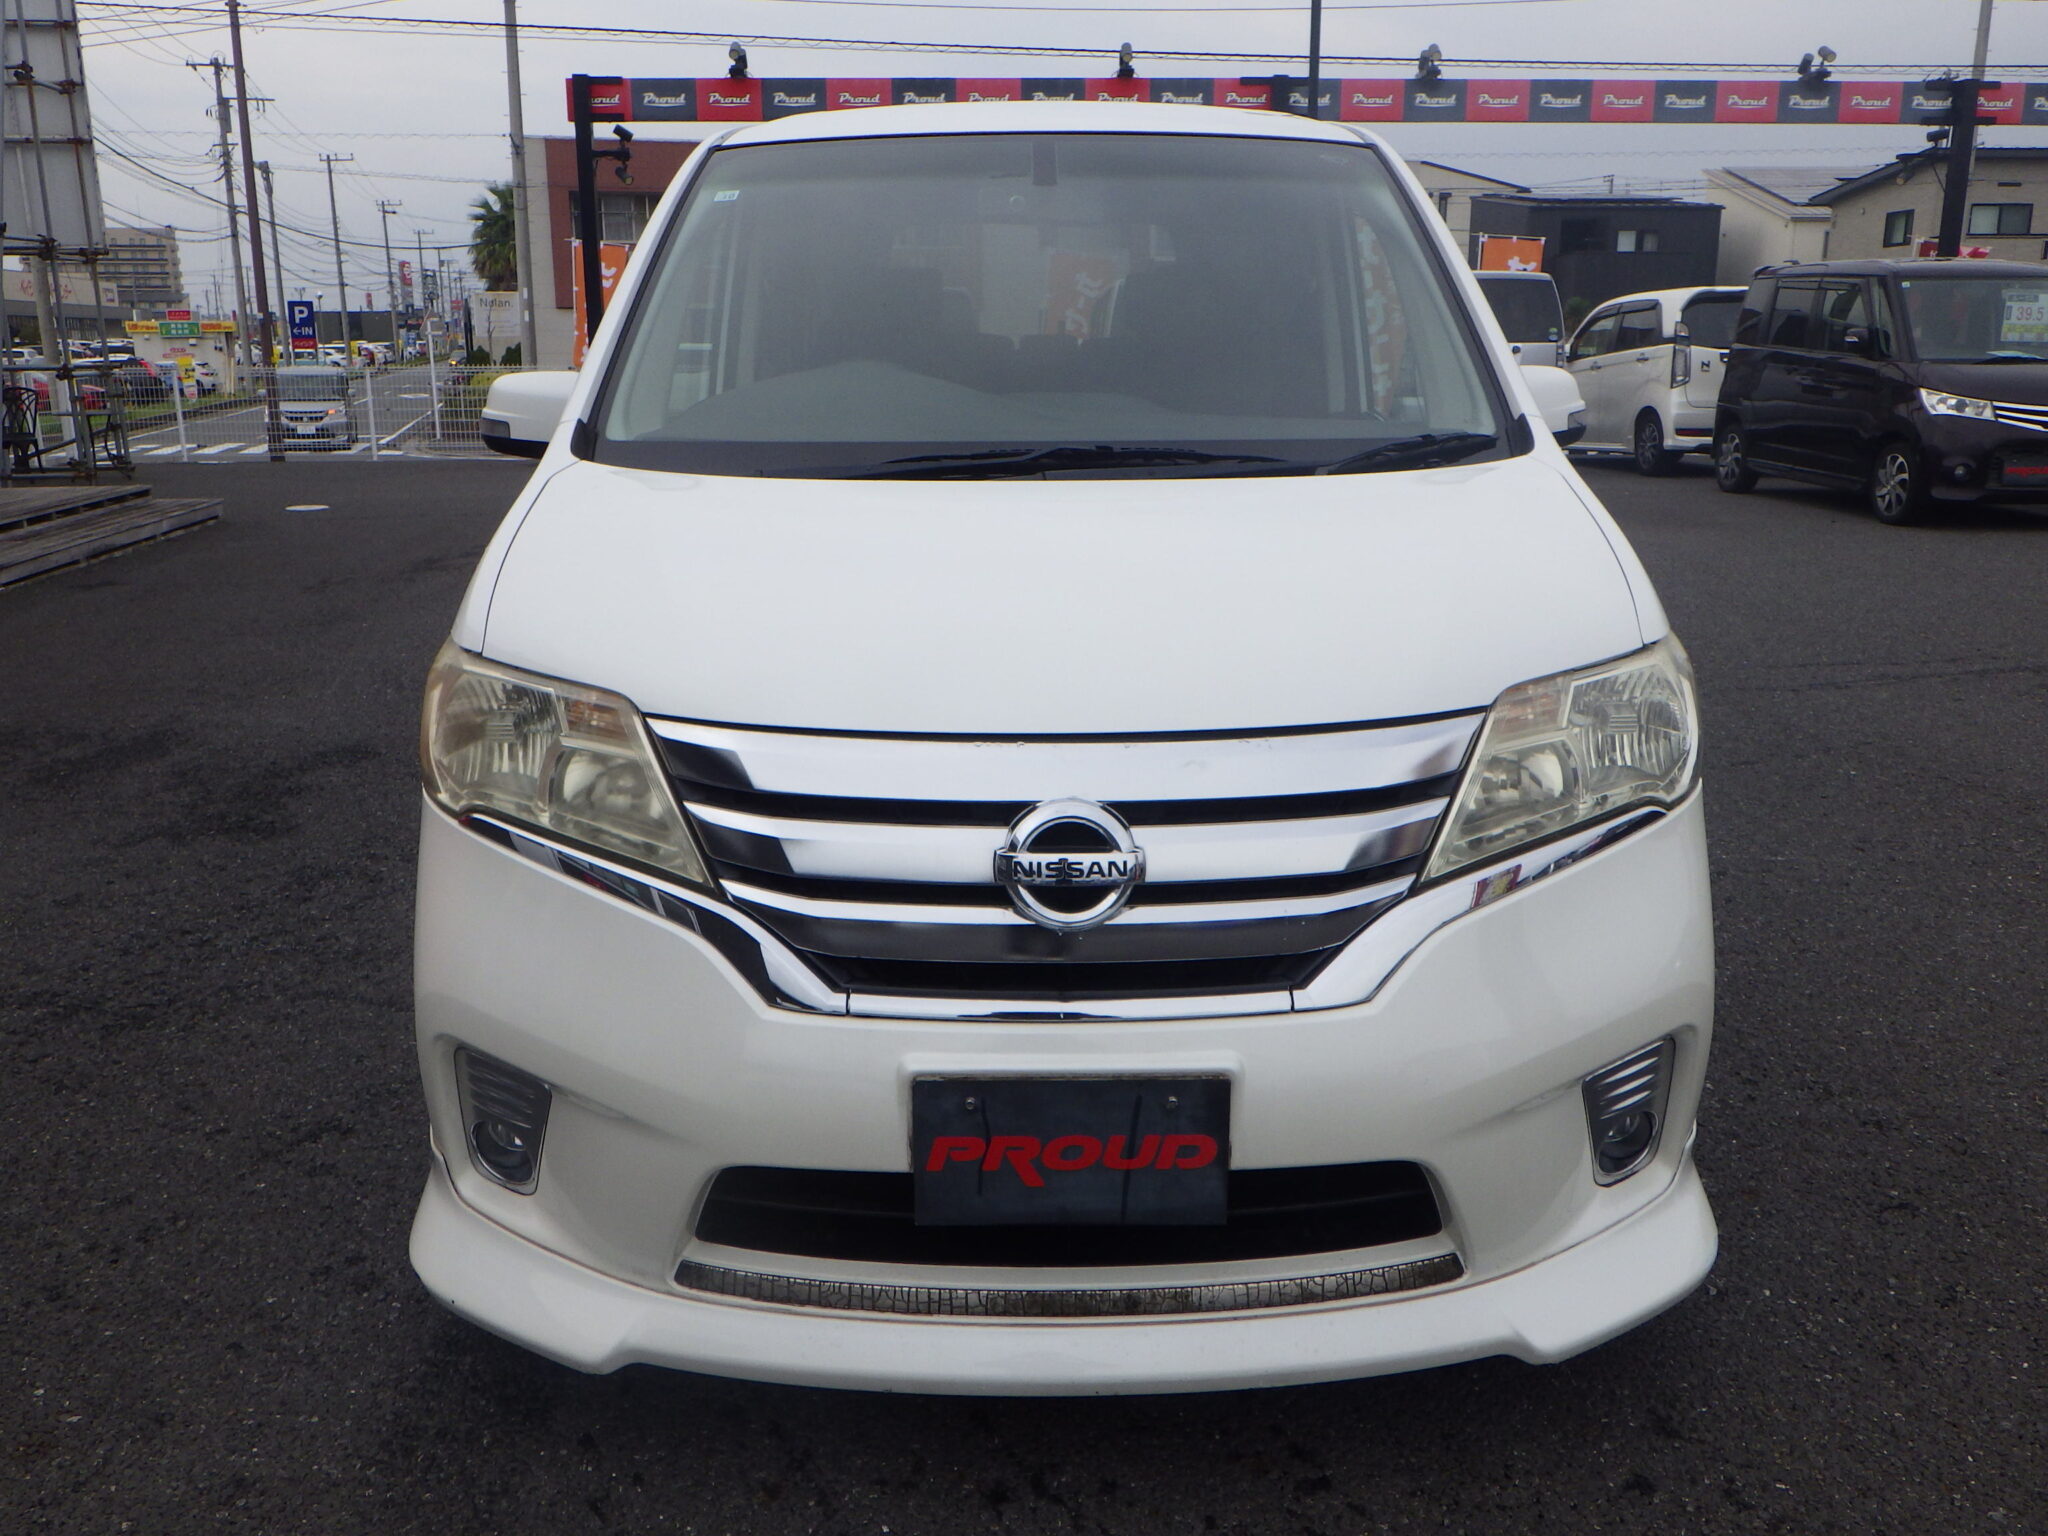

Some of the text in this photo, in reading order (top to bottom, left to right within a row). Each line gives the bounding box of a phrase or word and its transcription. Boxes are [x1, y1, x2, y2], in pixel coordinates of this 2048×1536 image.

[643, 92, 686, 107] Proud
[708, 92, 750, 107] Proud
[773, 92, 816, 107] Proud
[839, 92, 880, 106] Proud
[903, 92, 946, 104] Proud
[968, 92, 1010, 102] Proud
[1160, 92, 1203, 104] Proud
[1225, 92, 1267, 107] Proud
[1352, 93, 1393, 107] Proud
[1415, 93, 1456, 107] Proud
[1478, 93, 1519, 108] Proud
[1540, 93, 1582, 108] Proud
[1603, 94, 1644, 108] Proud
[1664, 94, 1706, 108] Proud
[1728, 95, 1768, 109] Proud
[1788, 95, 1830, 109] Proud
[1851, 95, 1892, 109] Proud
[1912, 95, 1952, 110] Proud
[294, 306, 309, 323] P
[302, 327, 313, 335] IN
[1013, 860, 1128, 879] NISSAN
[925, 1134, 1218, 1188] PROUD
